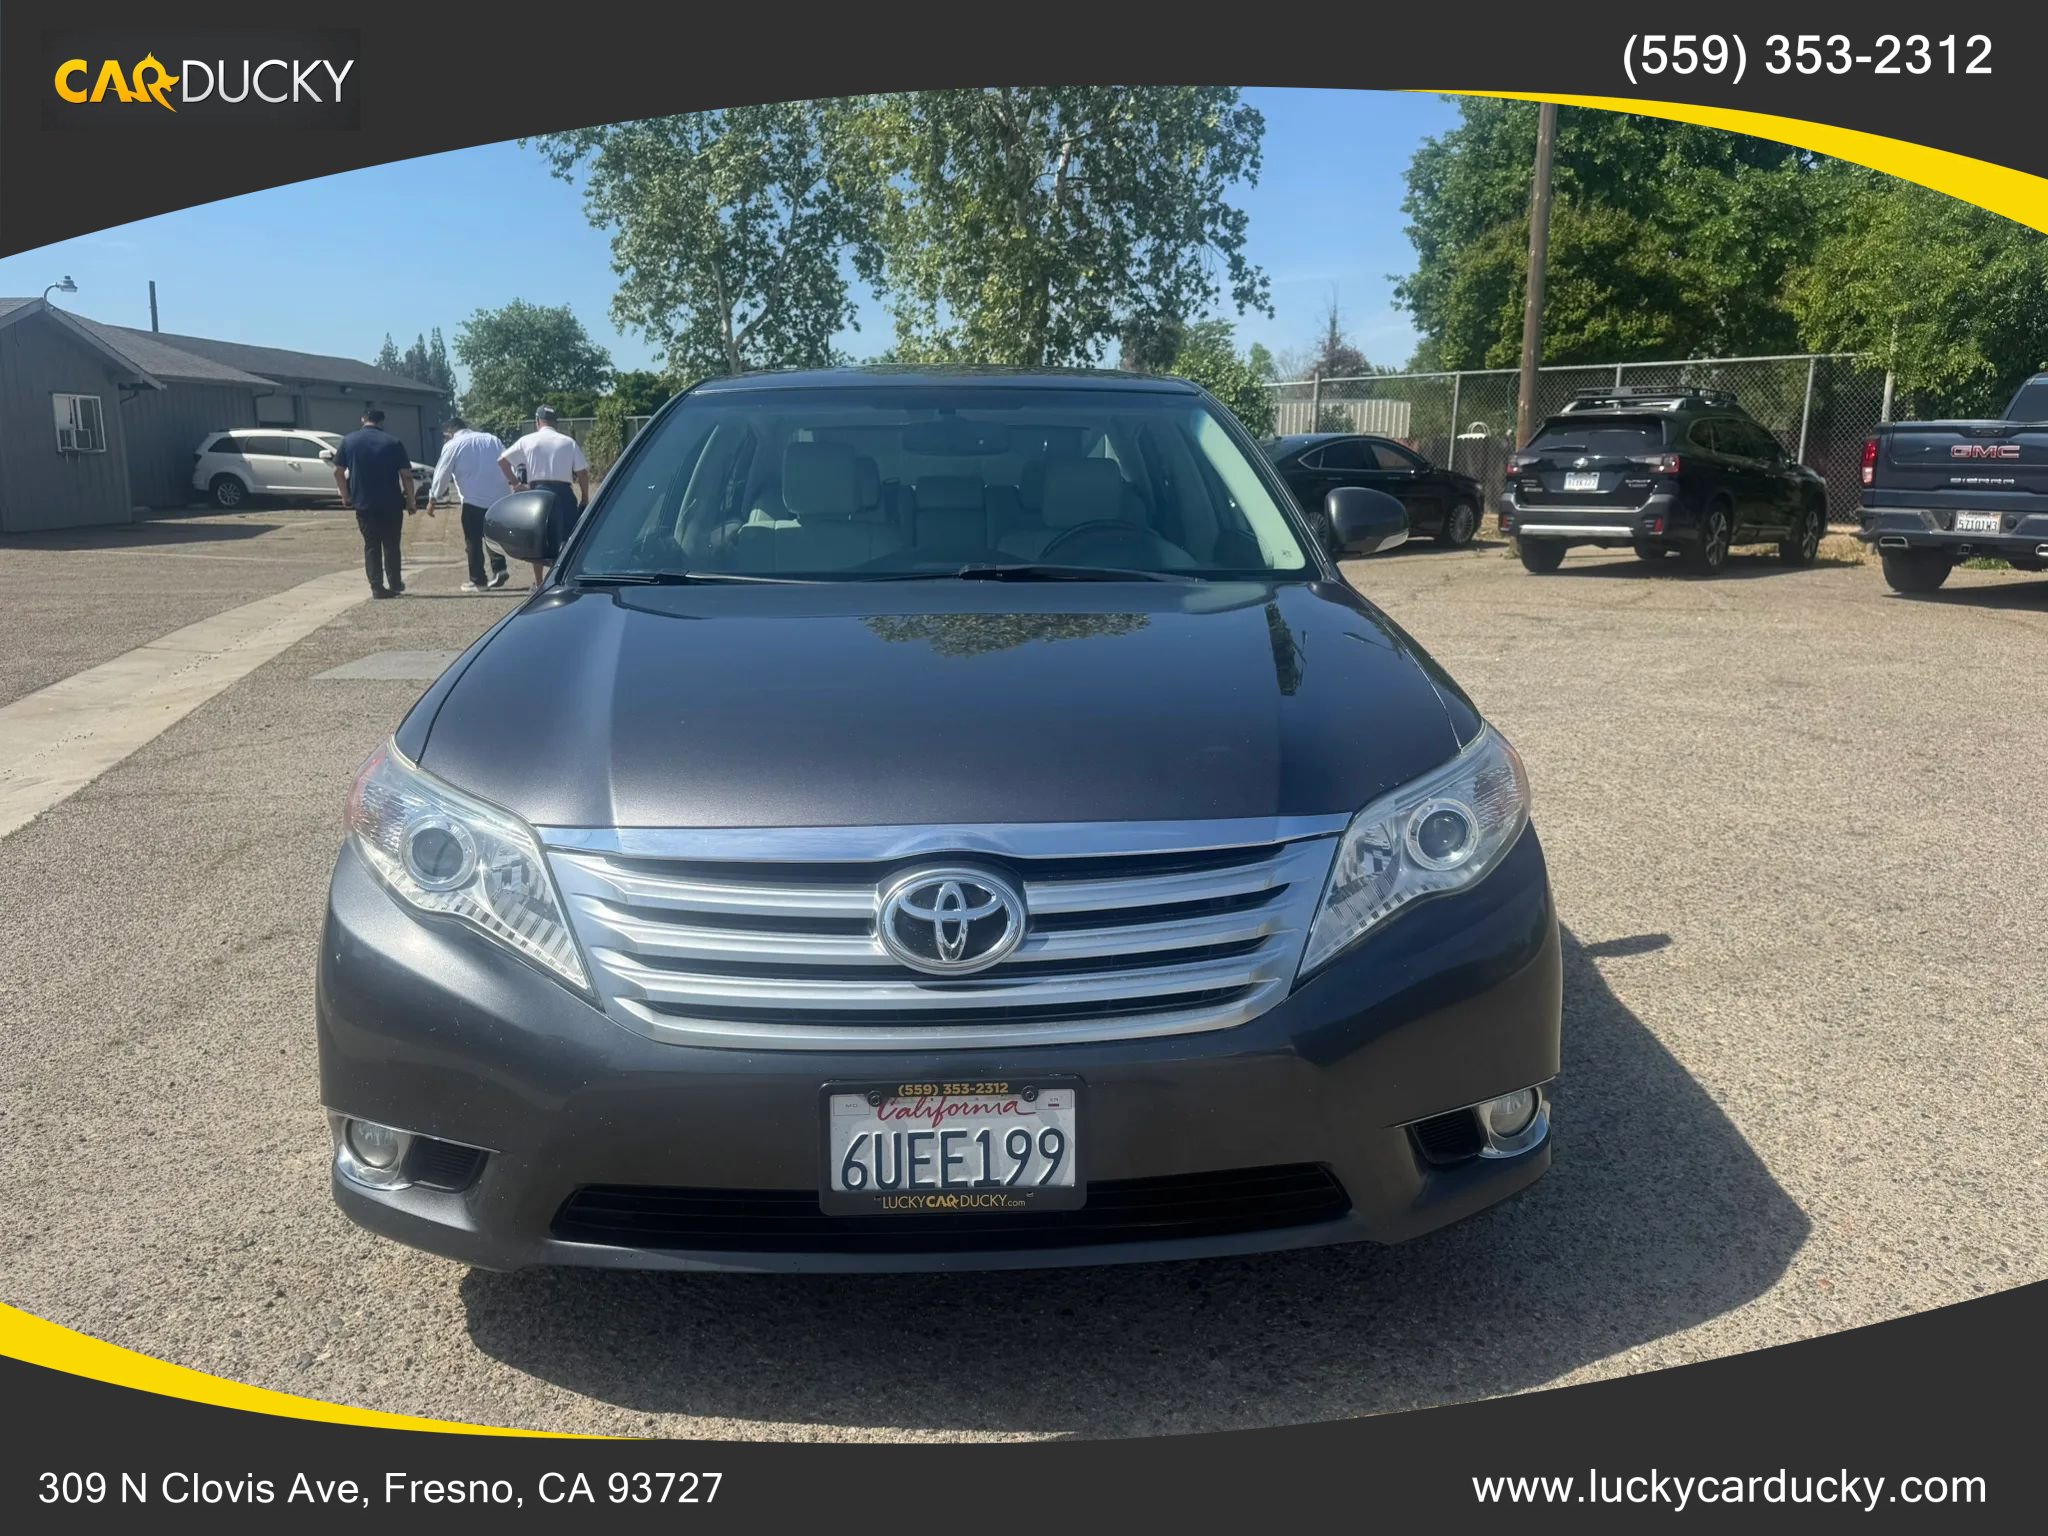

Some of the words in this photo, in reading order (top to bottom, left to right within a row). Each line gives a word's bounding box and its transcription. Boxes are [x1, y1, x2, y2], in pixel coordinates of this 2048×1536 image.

[1951, 445, 2020, 458] GMC
[898, 1083, 939, 1097] (559)
[943, 1082, 1009, 1095] 353-2312
[876, 1095, 1037, 1128] California
[840, 1127, 1066, 1191] 6UEE199
